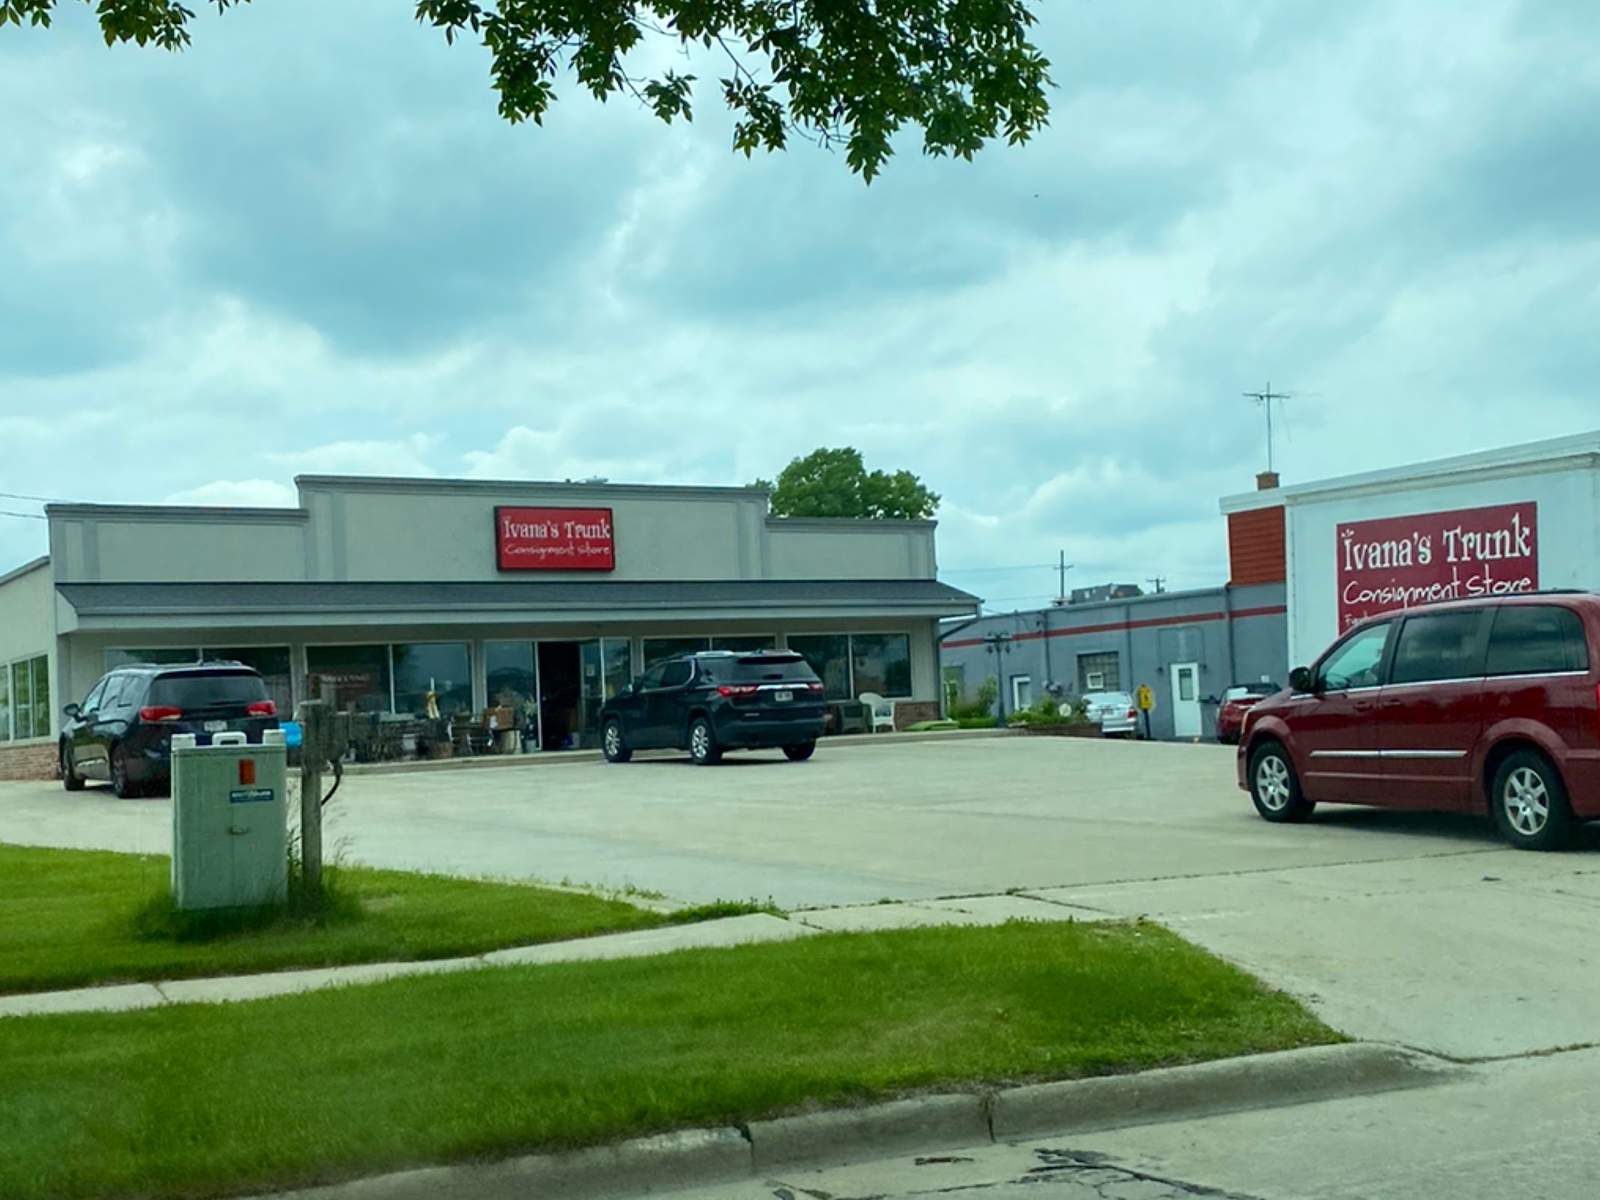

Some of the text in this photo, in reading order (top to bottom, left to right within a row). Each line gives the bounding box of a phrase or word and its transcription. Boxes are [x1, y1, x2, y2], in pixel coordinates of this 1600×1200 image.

[503, 515, 610, 538] Ivana's Trunk
[1341, 512, 1531, 571] Ivana's Trunk
[1343, 565, 1461, 609] Consignment
